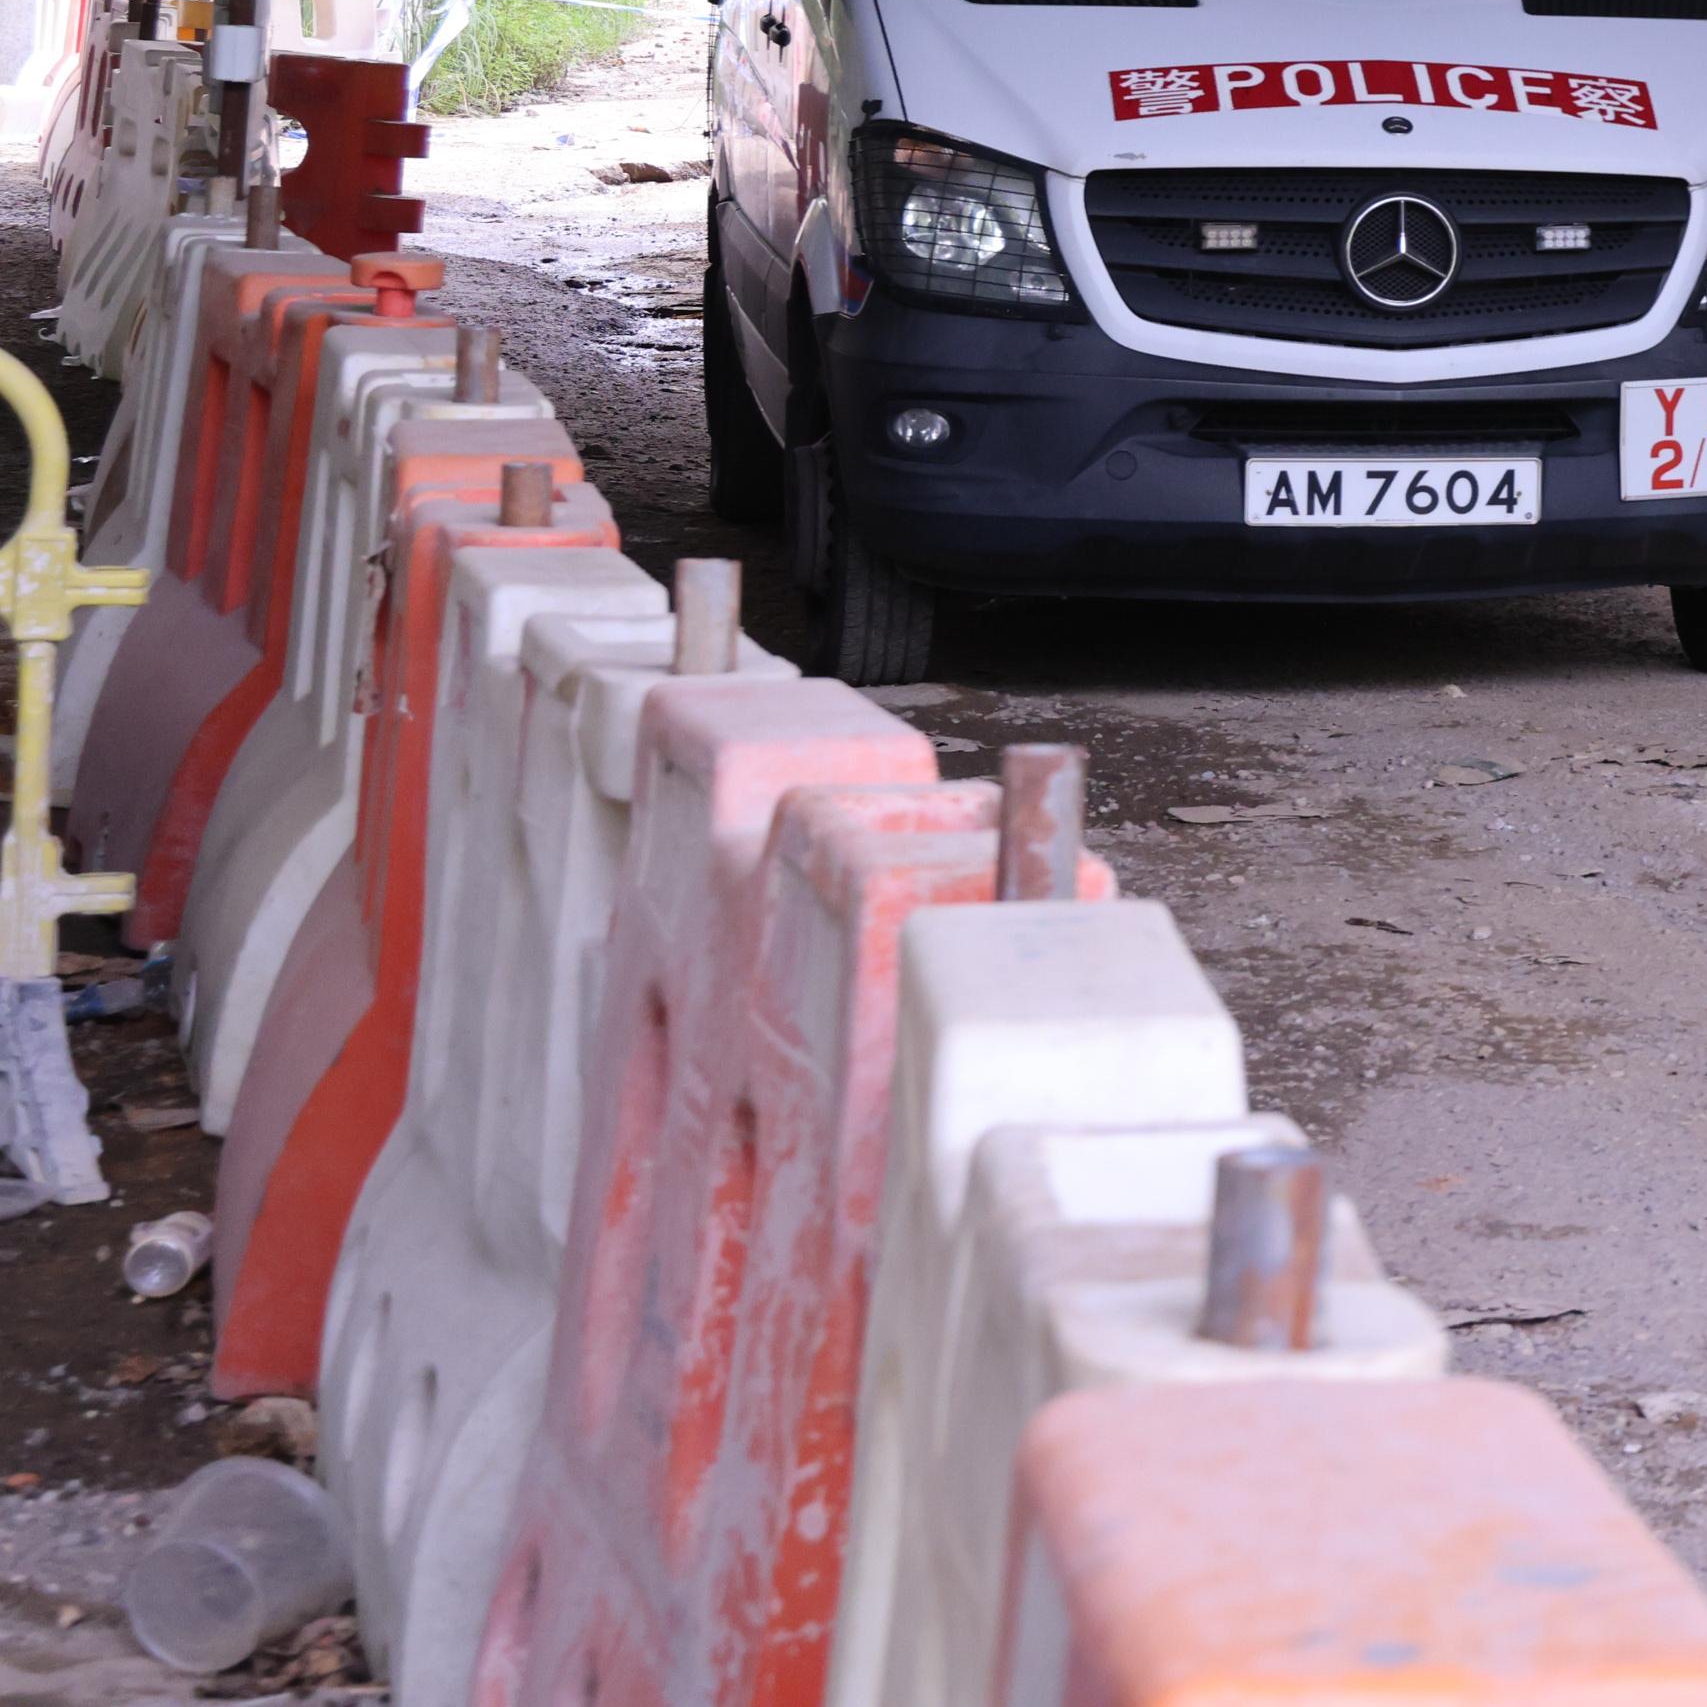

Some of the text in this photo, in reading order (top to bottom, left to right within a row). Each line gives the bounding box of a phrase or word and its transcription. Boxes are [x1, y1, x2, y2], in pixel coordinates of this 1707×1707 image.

[1120, 61, 1647, 126] 警 POLICE 察
[1266, 469, 1518, 516] AM 7604
